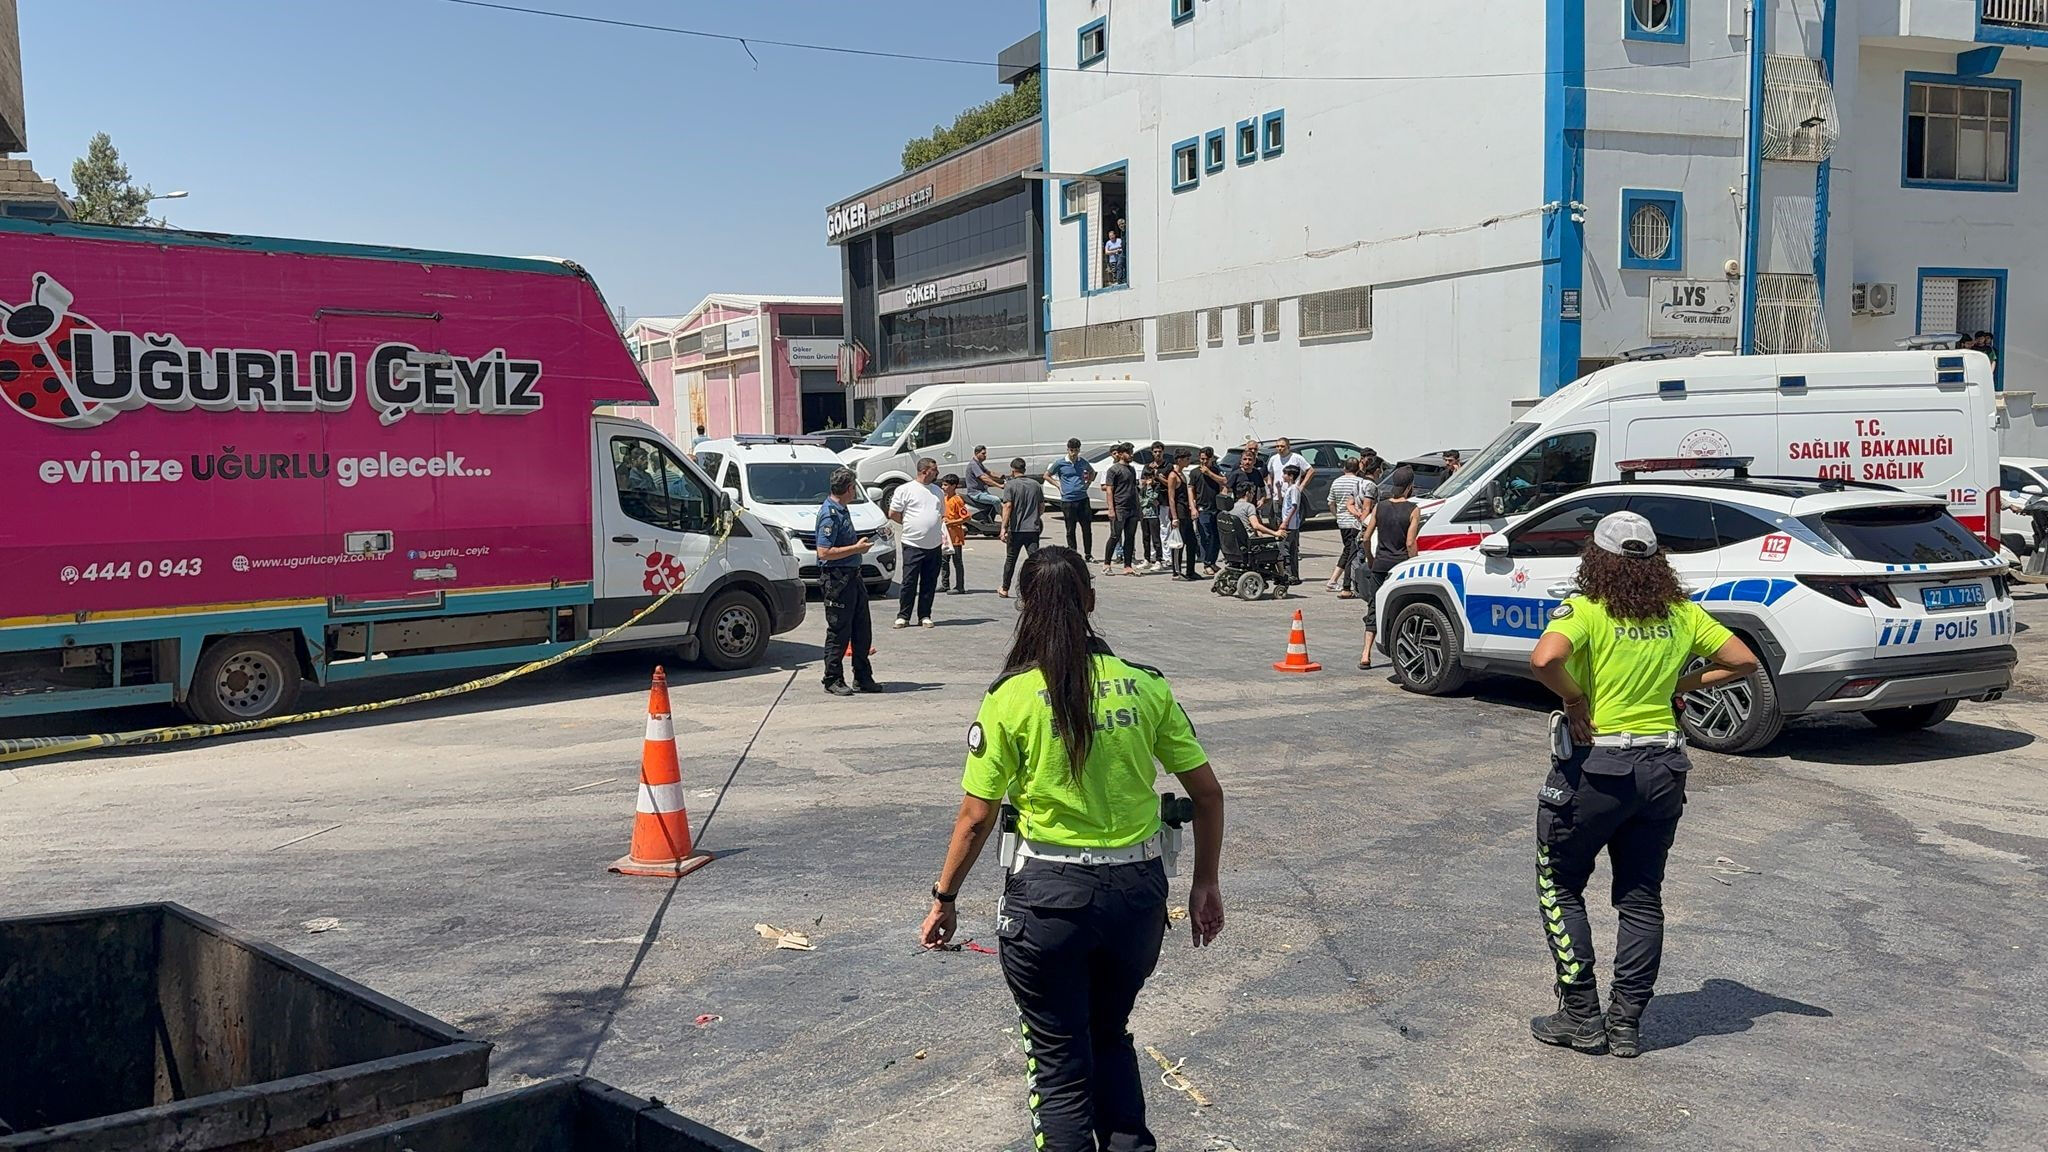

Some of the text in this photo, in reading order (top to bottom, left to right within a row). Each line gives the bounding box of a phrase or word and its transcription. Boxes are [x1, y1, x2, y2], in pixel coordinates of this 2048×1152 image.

[827, 203, 867, 237] GÖKER
[905, 283, 937, 305] GÖKER
[1673, 286, 1706, 307] LYS
[1684, 316, 1697, 324] OKUL
[73, 333, 541, 418] UĞURLU ÇEYİZ
[1855, 419, 1886, 437] T.C.
[1789, 434, 1953, 460] SAĞLIK BAKANLIĞI
[40, 445, 491, 487] evinize UĞURLU gelecek...
[1818, 459, 1924, 481] ACİL SAĞLIK
[1950, 489, 1977, 502] 112
[428, 546, 490, 560] ugurlu_ceyiz
[1766, 538, 1787, 552] 112
[82, 558, 202, 581] 444 0 943
[1930, 588, 1982, 604] 27 A 7215
[1614, 624, 1673, 641] POLİSİ
[1935, 616, 1978, 641] POLİS
[1037, 678, 1140, 706] TFİK
[1050, 707, 1139, 738] LİSİ
